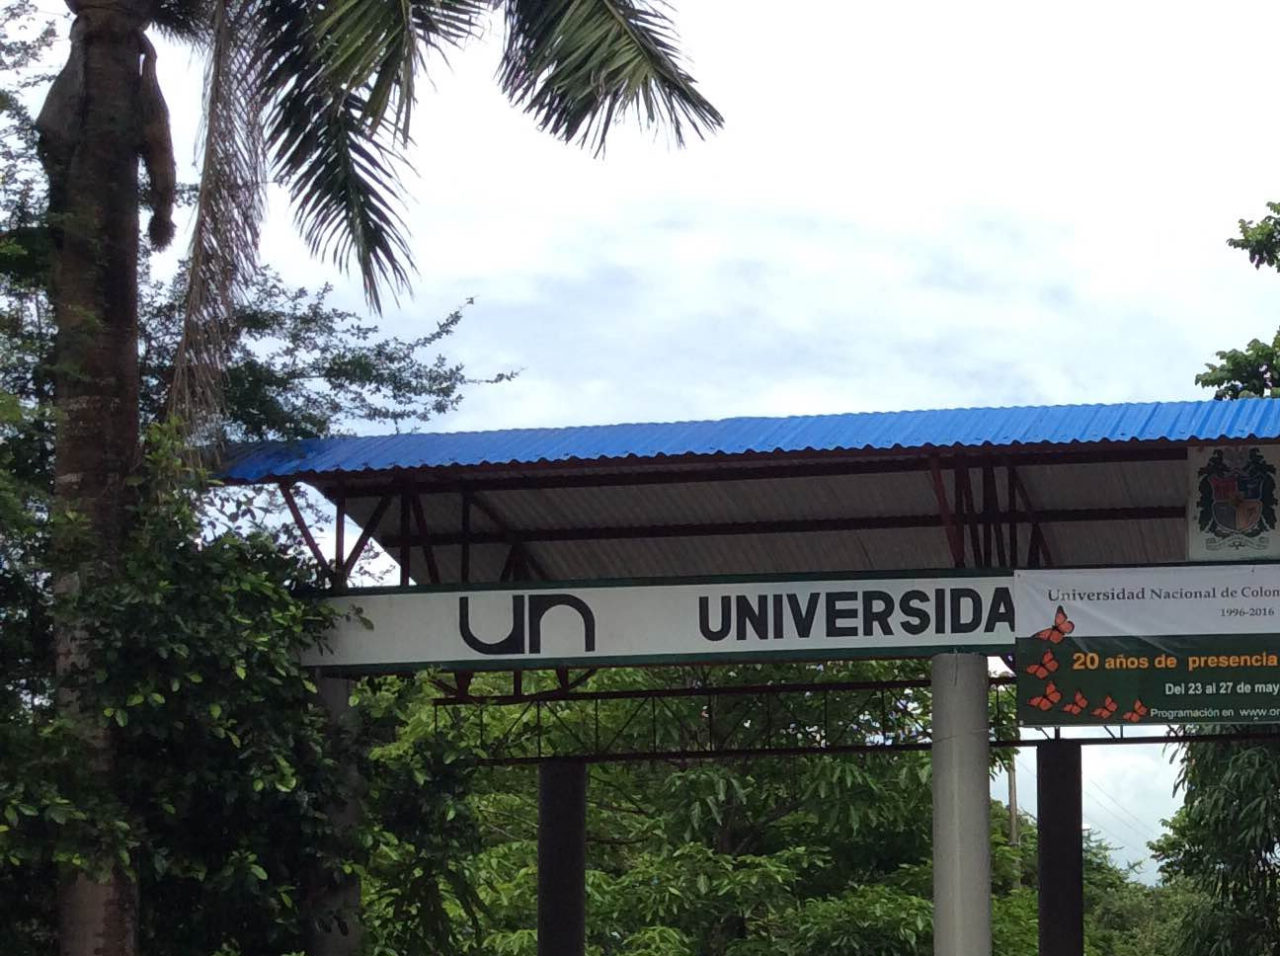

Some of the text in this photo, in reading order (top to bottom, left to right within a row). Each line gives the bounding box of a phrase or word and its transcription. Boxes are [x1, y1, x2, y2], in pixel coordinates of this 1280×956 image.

[1048, 587, 1145, 601] Universidad
[1150, 587, 1216, 600] Nacional
[1221, 587, 1237, 598] de
[699, 586, 1015, 641] UNIVERSIDA
[1221, 607, 1275, 617] 1996-2016
[1072, 652, 1099, 670] 20
[1105, 654, 1149, 669] años
[1154, 654, 1178, 669] de
[1188, 651, 1278, 672] presencia
[1165, 682, 1185, 695] Del
[1188, 682, 1203, 694] 23
[1206, 682, 1216, 694] al
[1219, 682, 1233, 694] 27
[1236, 681, 1251, 694] de
[1150, 707, 1220, 720] Programación
[1222, 709, 1234, 717] en
